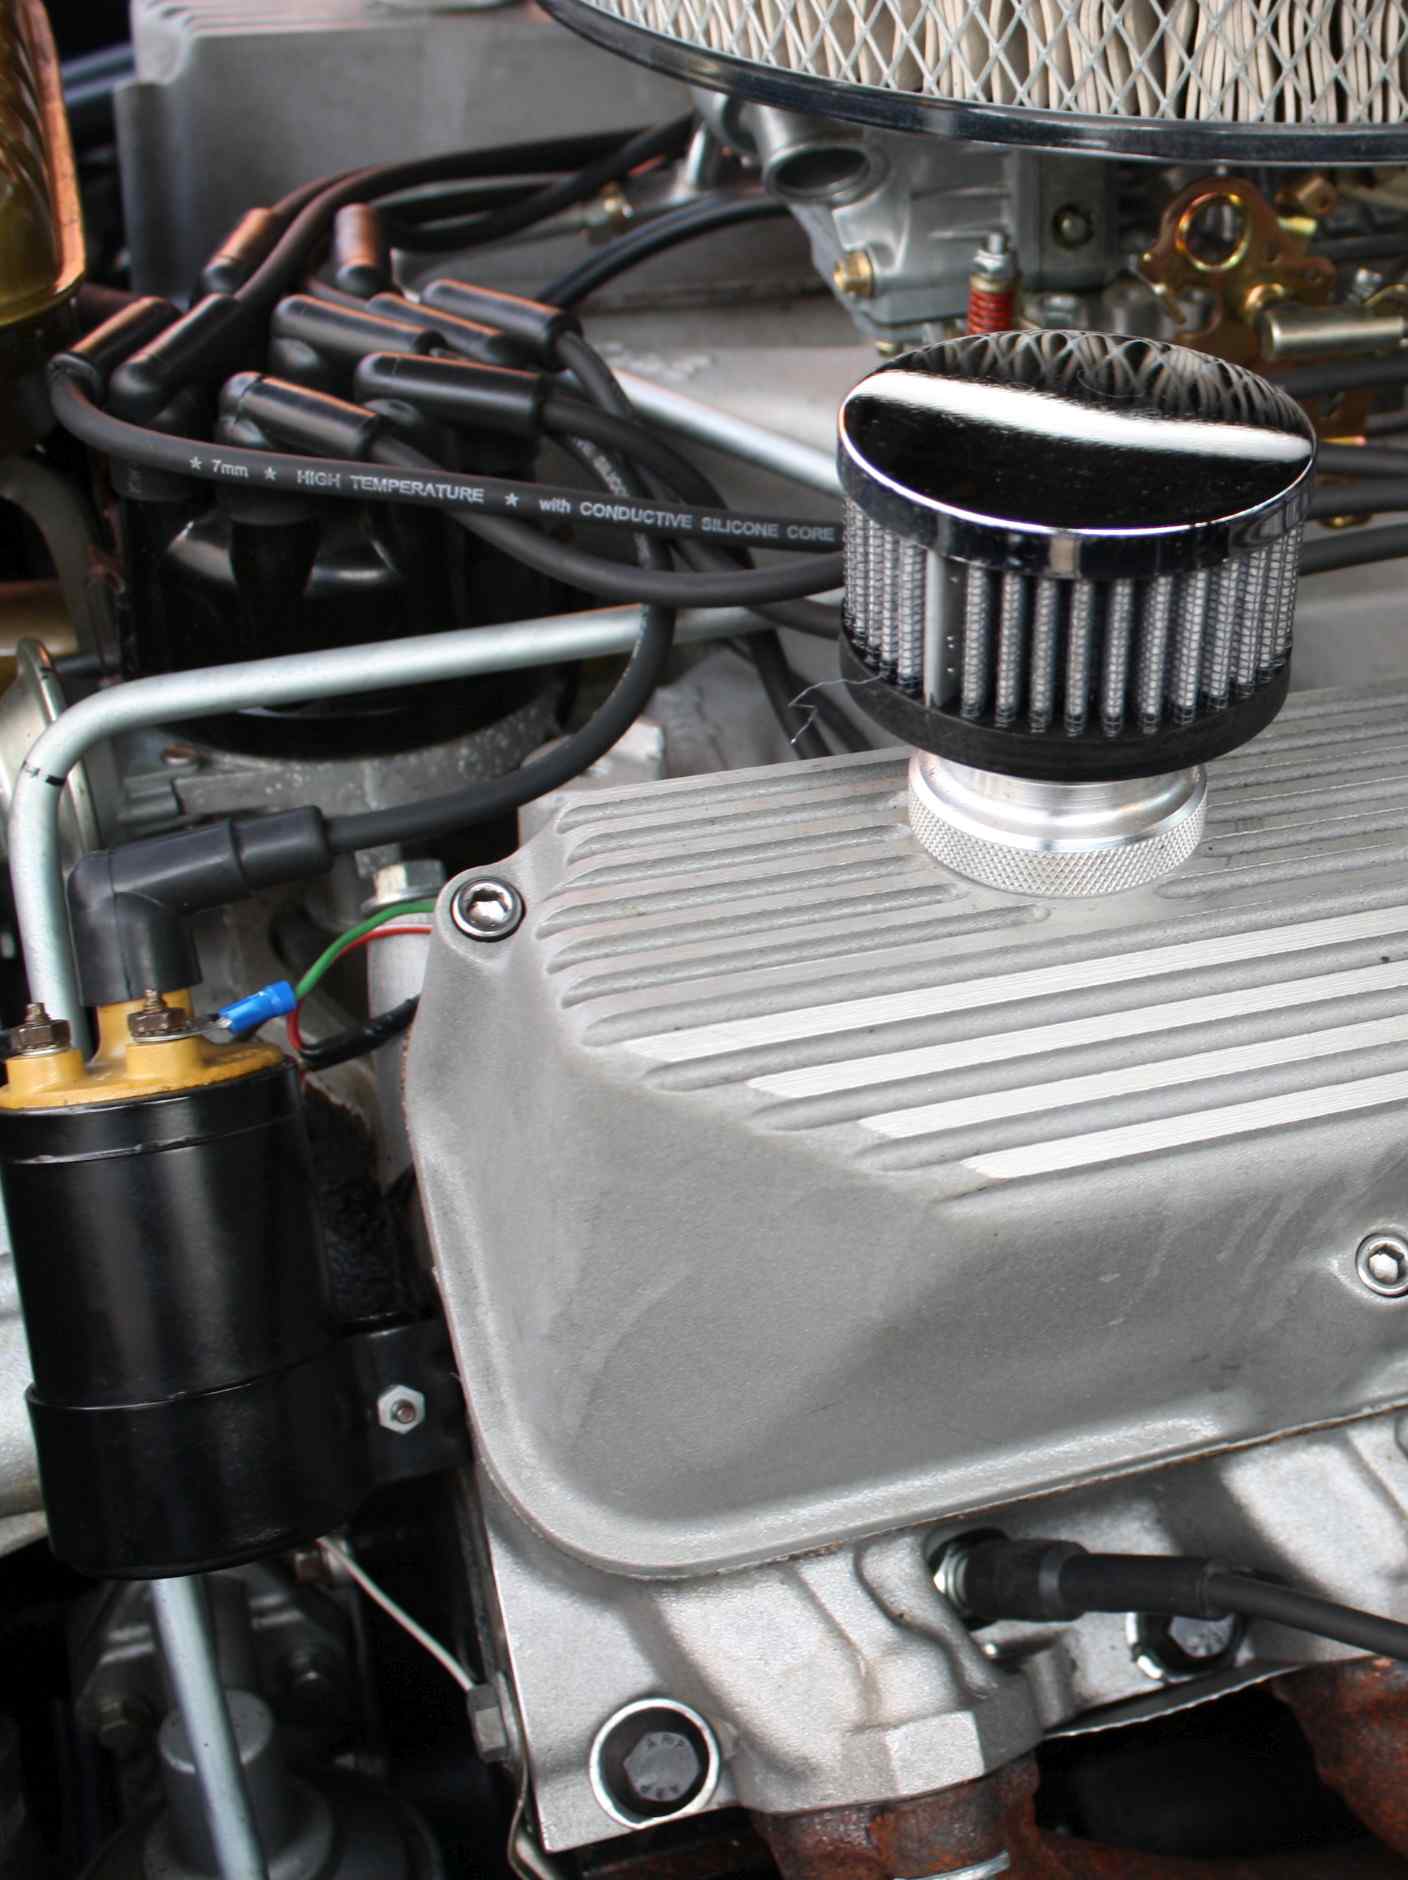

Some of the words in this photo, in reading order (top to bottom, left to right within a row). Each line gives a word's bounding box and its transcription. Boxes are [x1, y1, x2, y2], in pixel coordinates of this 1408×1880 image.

[211, 459, 249, 478] 7mm
[297, 469, 341, 488] HIGH
[350, 474, 485, 503] TEMPERATURE
[539, 498, 571, 513] with
[580, 501, 693, 530] CONDUCTIVE
[700, 516, 779, 538] SILICONE
[787, 525, 835, 541] CORE
